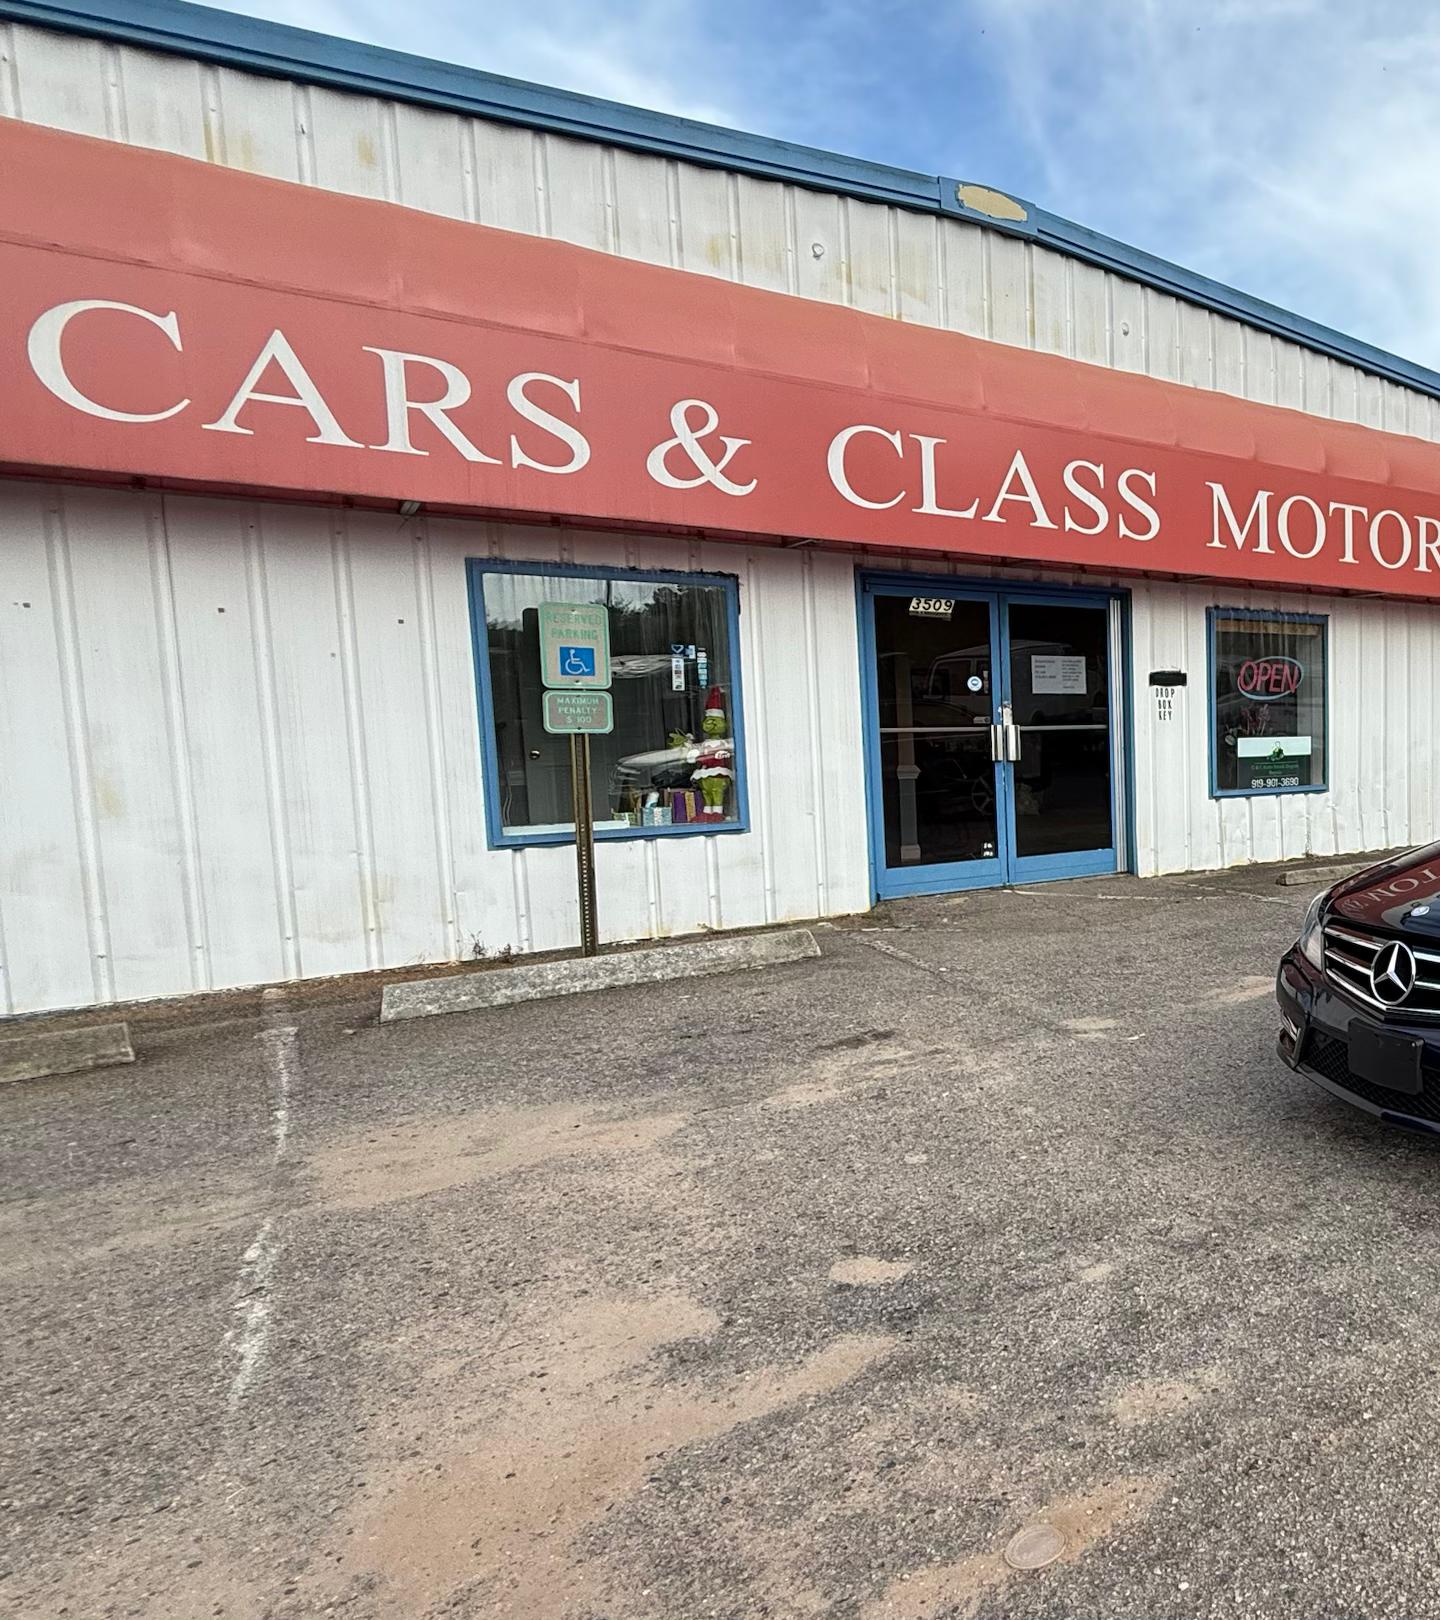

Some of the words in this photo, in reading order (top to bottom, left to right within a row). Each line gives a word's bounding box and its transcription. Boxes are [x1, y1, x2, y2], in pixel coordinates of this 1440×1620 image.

[27, 299, 591, 474] CARS
[646, 398, 758, 497] &
[826, 424, 1162, 541] CLASS
[912, 598, 953, 612] 3509
[545, 612, 602, 625] RESERVED
[552, 627, 598, 640] PARKING
[1239, 660, 1299, 693] OPEN
[1155, 687, 1175, 698] DROP
[557, 697, 599, 705] MAXIMUM
[1158, 699, 1172, 709] BOX
[558, 706, 597, 714] PENALTY
[1158, 710, 1172, 720] KEY
[1251, 777, 1299, 788] 919-901-3690
